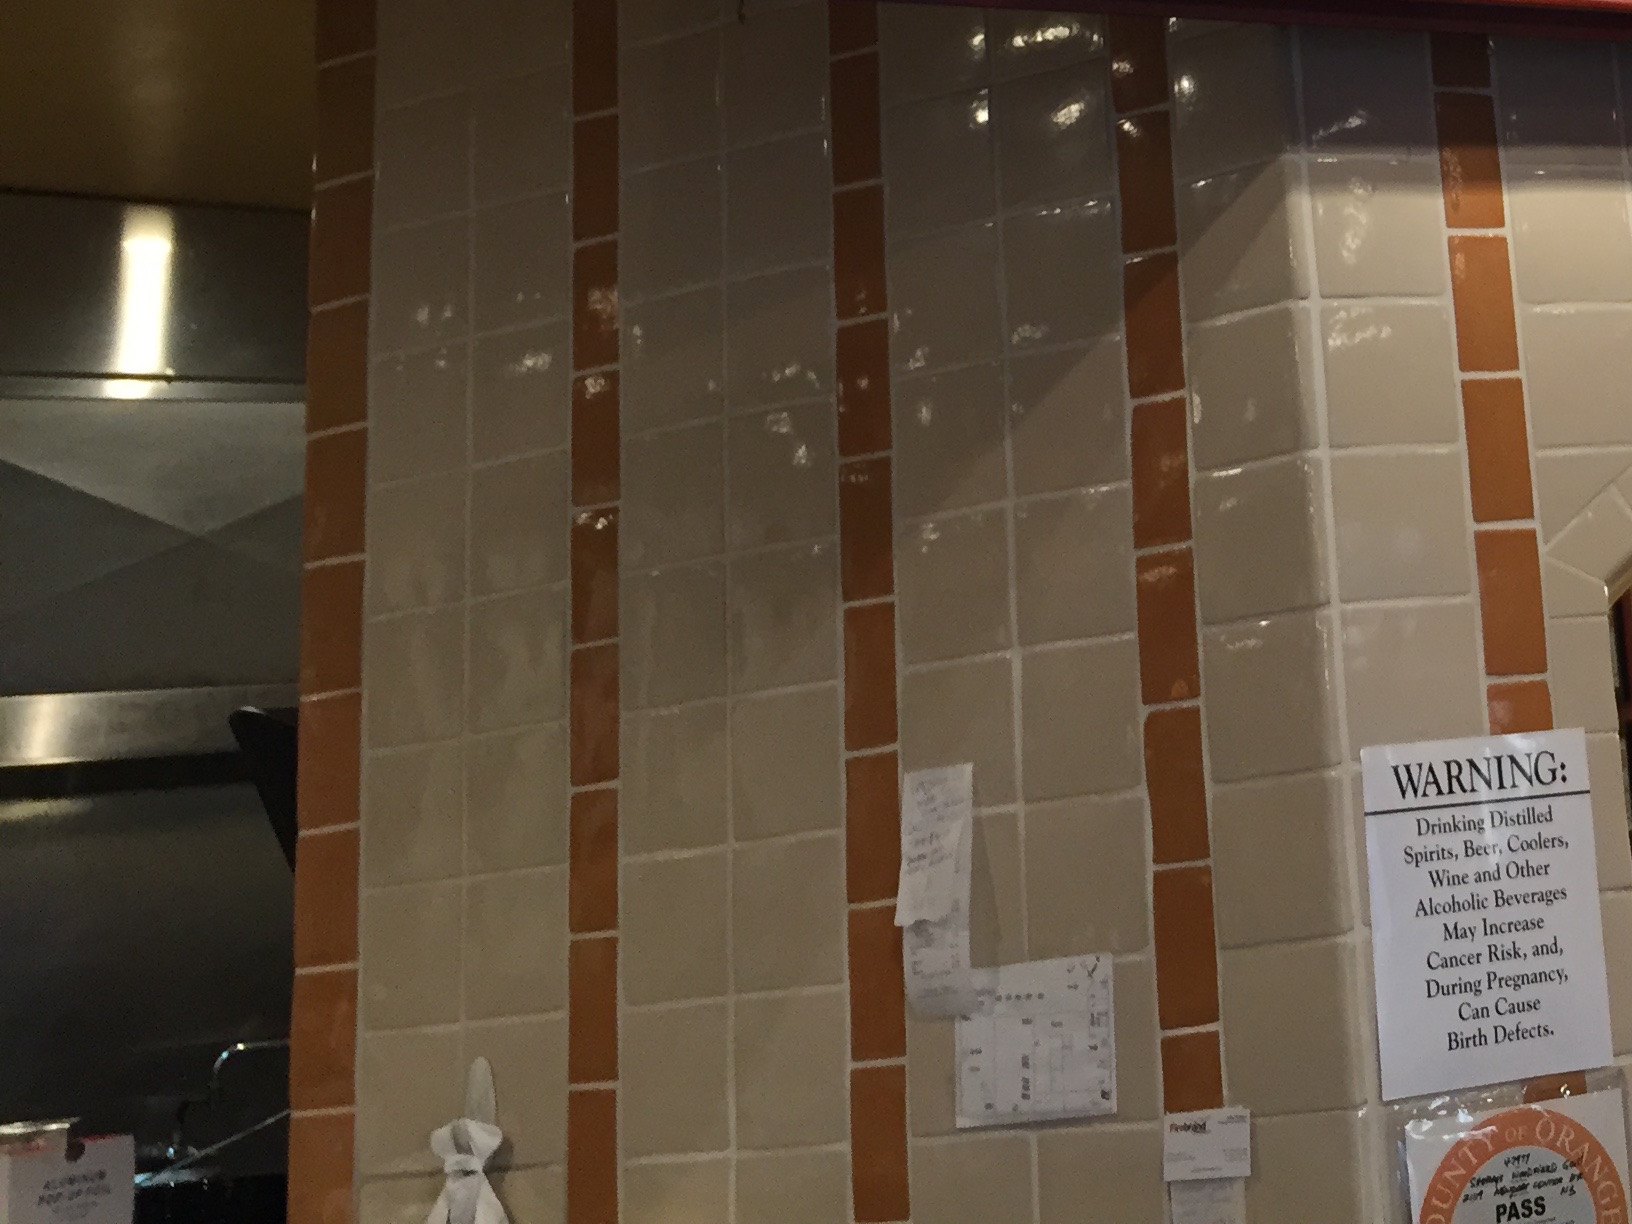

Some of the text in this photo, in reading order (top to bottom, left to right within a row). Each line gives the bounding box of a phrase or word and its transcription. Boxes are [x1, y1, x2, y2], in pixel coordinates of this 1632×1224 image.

[1393, 750, 1567, 800] WARNING:
[1416, 805, 1553, 838] Drinking Distilled
[1404, 831, 1569, 867] Spirits, Beer, Coolers,
[1428, 860, 1550, 888] Wine and Other
[1415, 885, 1567, 918] Alcoholic Beverages
[1442, 913, 1545, 943] May Increase
[1426, 936, 1564, 971] Cancer Risk, and,
[1425, 967, 1569, 1000] During Pregnancy,
[1458, 993, 1541, 1021] Can Cause
[1447, 1020, 1554, 1051] Birth Defects.
[1496, 1195, 1546, 1223] PASS
